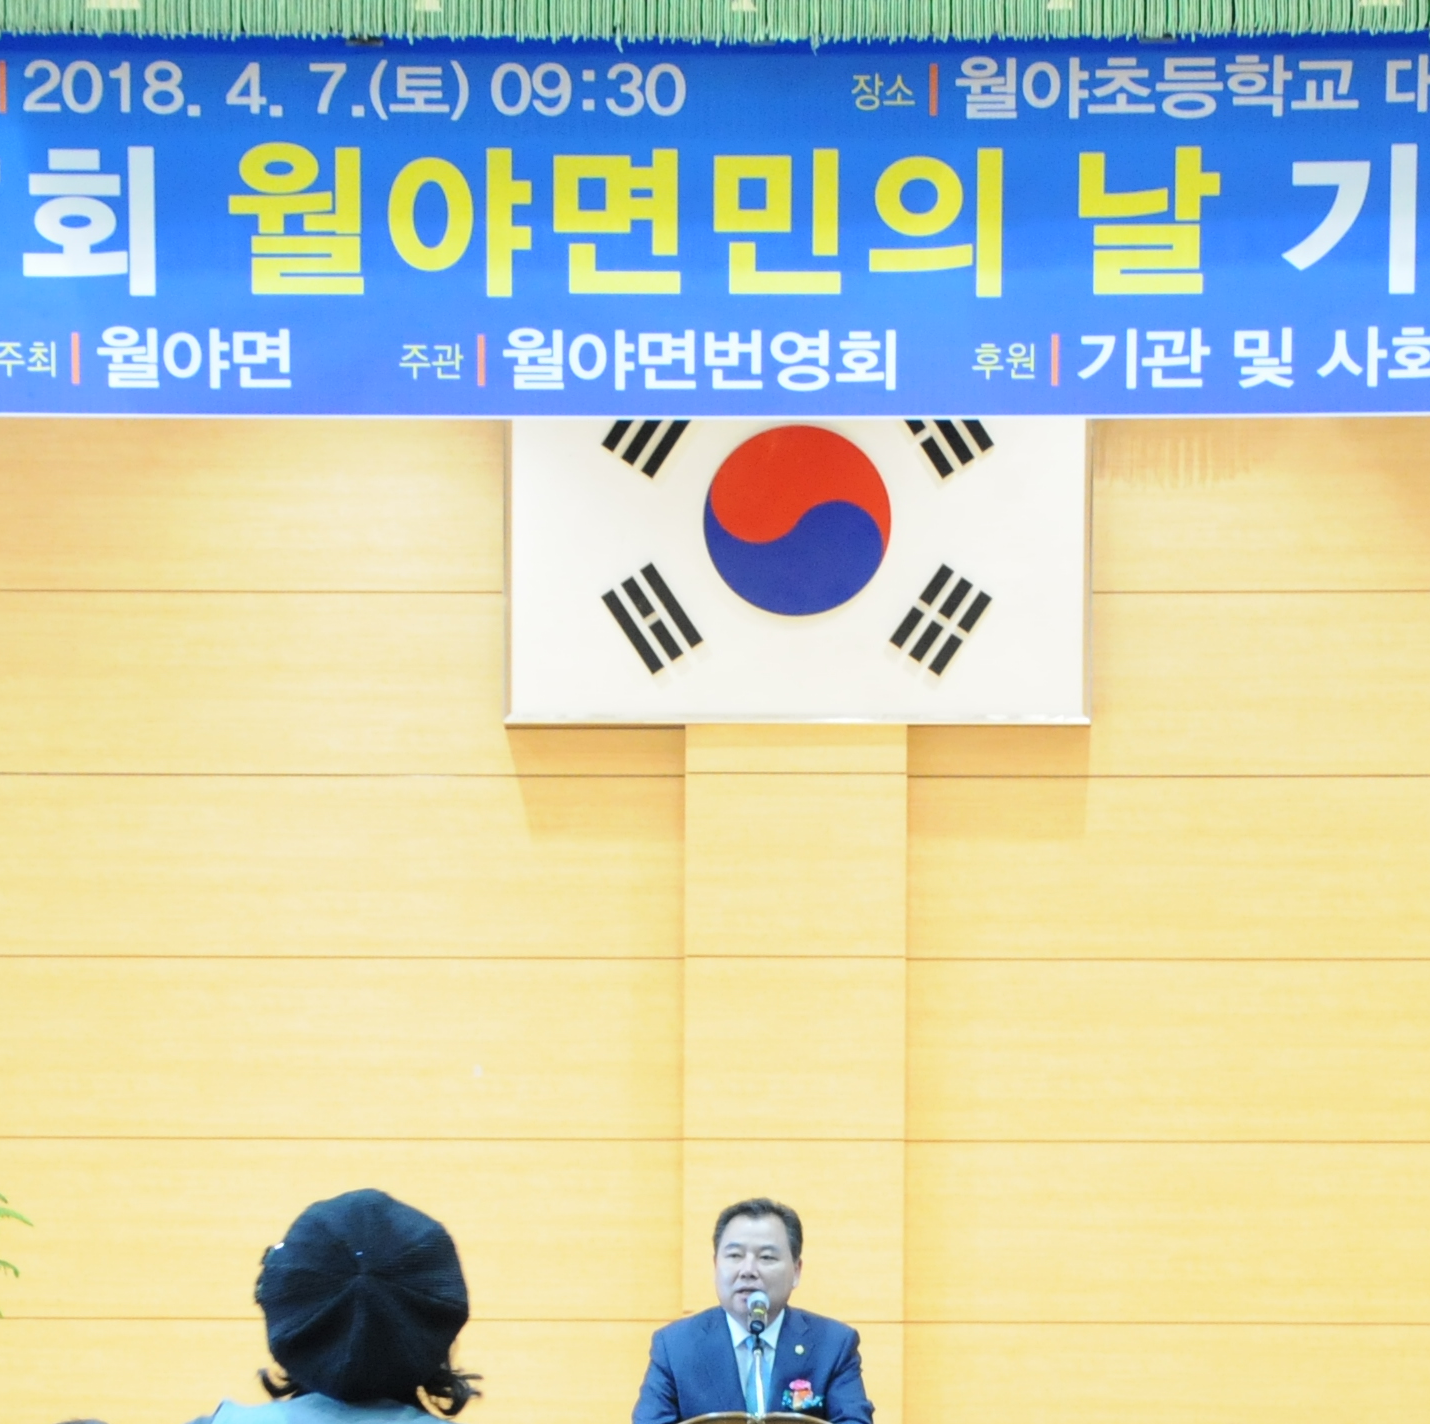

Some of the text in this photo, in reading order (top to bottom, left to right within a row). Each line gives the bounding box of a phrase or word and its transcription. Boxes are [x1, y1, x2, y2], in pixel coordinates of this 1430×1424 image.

[22, 59, 202, 118] 2018.
[225, 61, 284, 118] 4.
[308, 59, 470, 121] 7.(토)
[490, 61, 688, 117] 09:30
[851, 72, 916, 109] 장소
[954, 54, 1360, 119] 월야초등학교
[228, 142, 1004, 298] 월야면민의
[1077, 146, 1221, 295] 날
[96, 326, 293, 390] 월야면
[398, 327, 897, 392] 주관 월야면번영회
[971, 342, 1035, 381] 후원
[1077, 327, 1211, 390] 기관
[1233, 326, 1296, 390] 및
